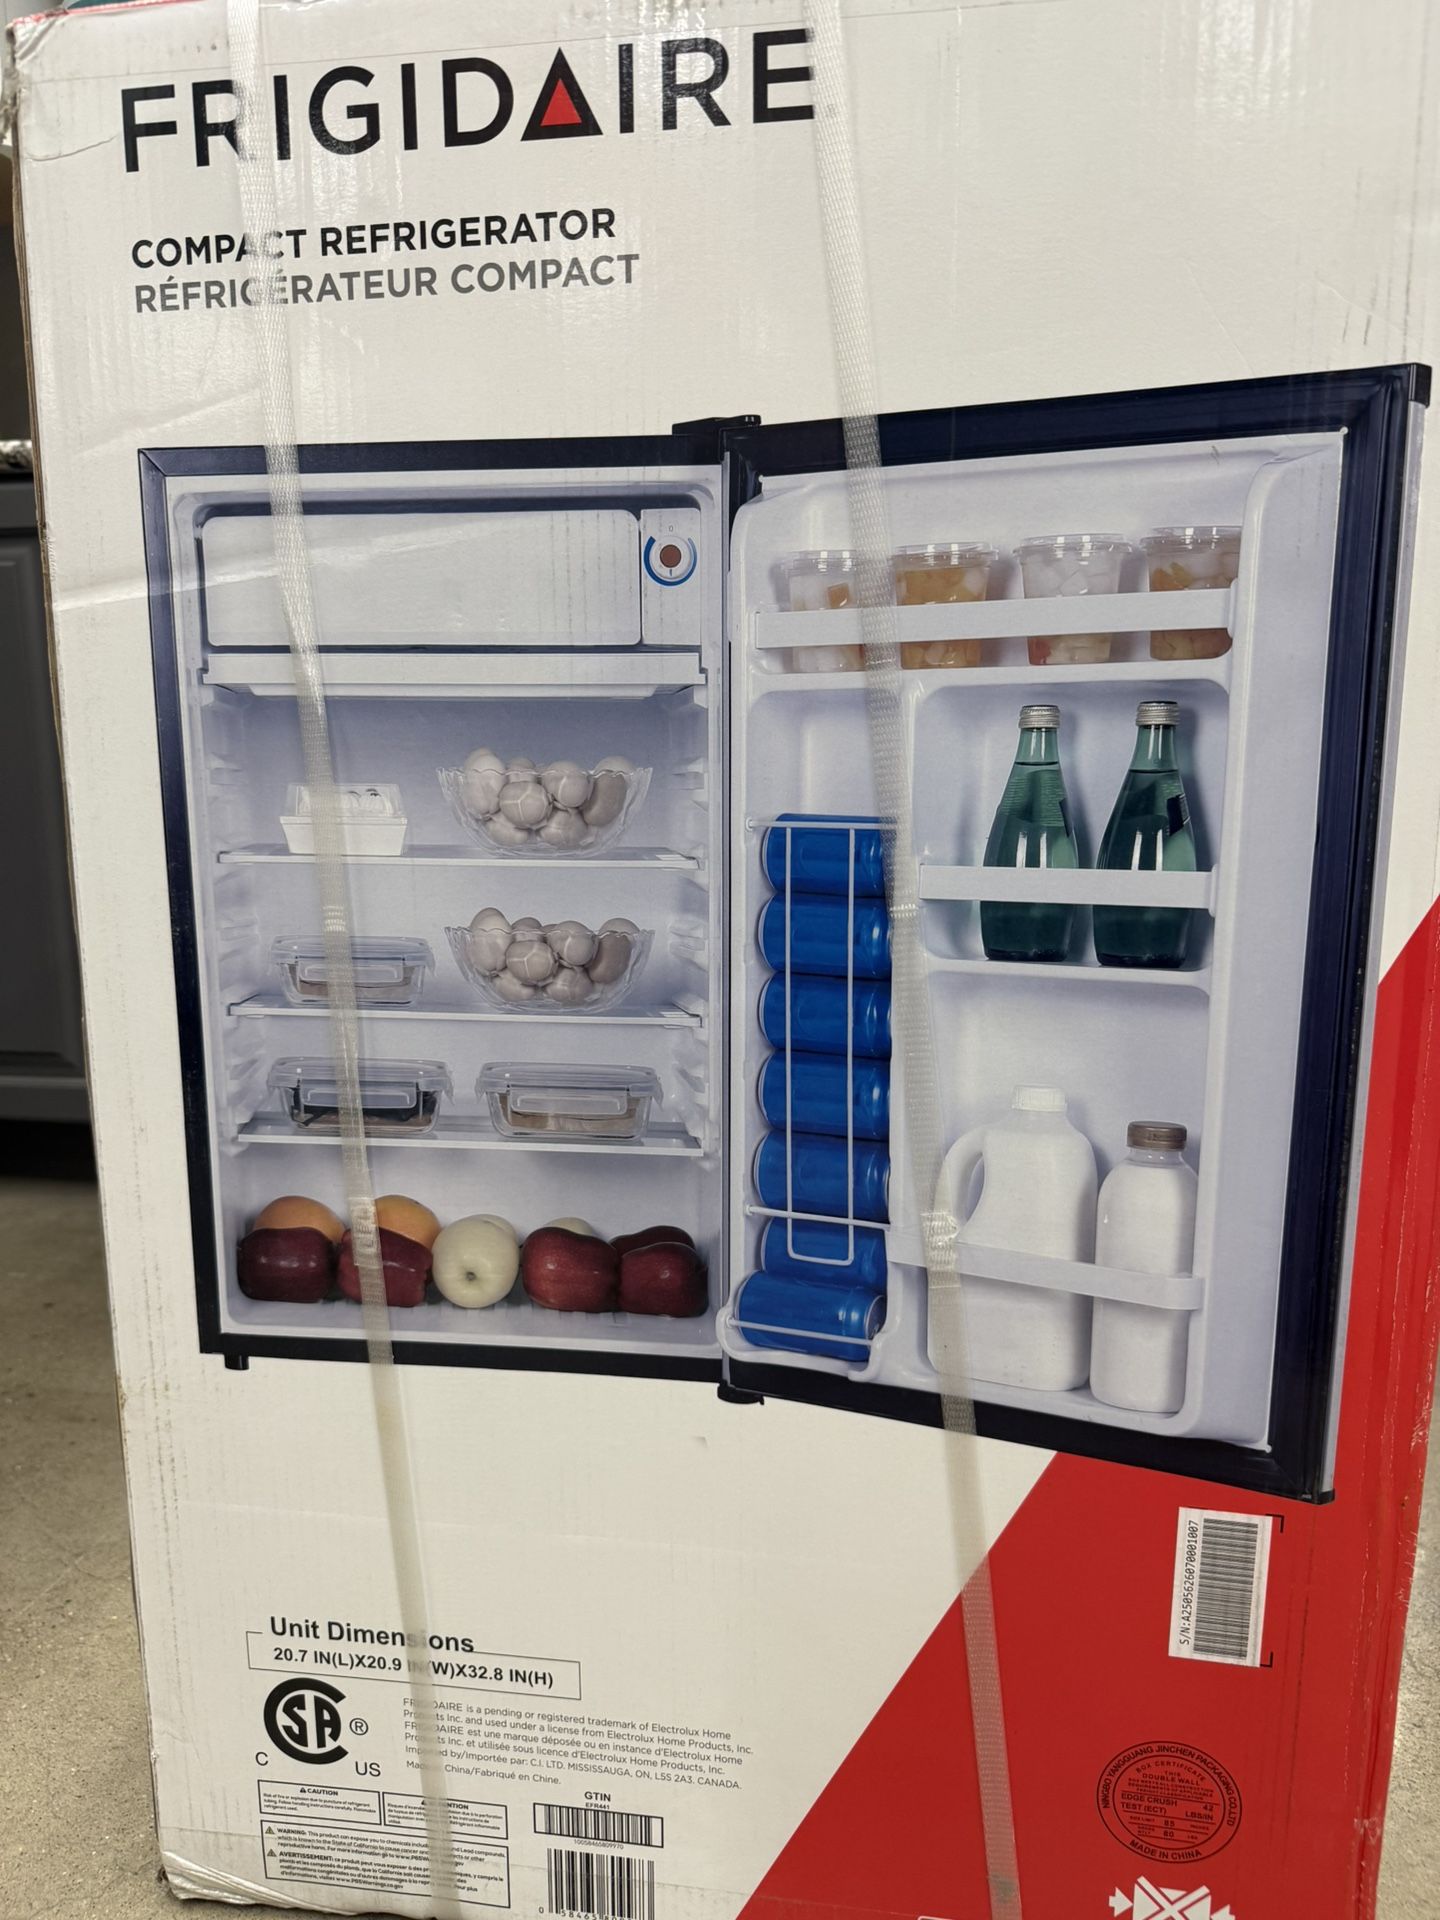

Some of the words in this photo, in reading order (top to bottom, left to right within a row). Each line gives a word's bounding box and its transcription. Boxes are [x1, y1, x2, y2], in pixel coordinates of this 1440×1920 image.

[120, 27, 816, 173] FRIGIDAIRE
[131, 228, 307, 270] COMPACT
[320, 206, 617, 258] REFRIGERATOR
[450, 252, 640, 295] COMPACT
[270, 1616, 320, 1640] Unit
[327, 1620, 475, 1653] Dimenons
[273, 1647, 308, 1664] 20.7
[313, 1650, 402, 1672] IN(L)X20.9
[509, 1668, 554, 1690] IN(H)
[466, 1704, 474, 1713] is
[484, 1707, 522, 1720] pending
[537, 1713, 585, 1724] registered
[587, 1717, 636, 1730] trademark
[639, 1722, 649, 1731] of
[651, 1723, 700, 1736] Electrolux
[702, 1729, 731, 1740] Home
[447, 1713, 463, 1723] Inc.
[465, 1717, 483, 1726] and
[485, 1719, 507, 1728] used
[509, 1721, 537, 1731] under
[547, 1724, 580, 1736] license
[582, 1727, 605, 1738] from
[607, 1730, 655, 1743] Electrolux
[657, 1735, 686, 1747] Home
[688, 1739, 734, 1753] Products,
[736, 1744, 754, 1754] Inc.
[448, 1736, 464, 1746] Inc.
[466, 1739, 476, 1748] et
[478, 1741, 511, 1752] utilisée
[513, 1745, 534, 1754] sous
[536, 1746, 569, 1758] licence
[571, 1749, 628, 1764] d'Electrolux
[629, 1756, 658, 1768] Home
[660, 1759, 706, 1774] Products,
[708, 1765, 726, 1775] Inc.
[467, 1729, 481, 1737] est
[483, 1731, 501, 1739] une
[503, 1733, 539, 1743] marque
[541, 1735, 582, 1747] déposée
[583, 1741, 596, 1749] ou
[598, 1742, 610, 1750] en
[612, 1742, 652, 1755] instance
[654, 1747, 711, 1762] d'Electrolux
[714, 1754, 743, 1765] Home
[255, 1751, 269, 1767] C
[355, 1761, 381, 1777] US
[450, 1749, 508, 1763] by/Importée
[546, 1760, 565, 1770] LTD.
[697, 1777, 742, 1789] CANADA.
[444, 1764, 516, 1780] China/Fabriqué
[518, 1773, 530, 1781] en
[532, 1774, 562, 1785] Chine.
[1143, 1773, 1176, 1782] DOUBLE
[1178, 1778, 1200, 1786] WALL
[307, 1787, 338, 1796] CAUTION
[584, 1791, 611, 1802] GTIN
[1121, 1793, 1145, 1803] EDGE
[1147, 1796, 1178, 1807] CRUSH
[1120, 1802, 1143, 1810] TEST
[1144, 1805, 1167, 1815] (ECT)
[277, 1827, 307, 1837] WARNING:
[279, 1850, 334, 1862] AVERTISSEMENT:
[1129, 1839, 1157, 1857] MADE
[1160, 1850, 1169, 1860] IN
[1171, 1848, 1202, 1860] CHINA
